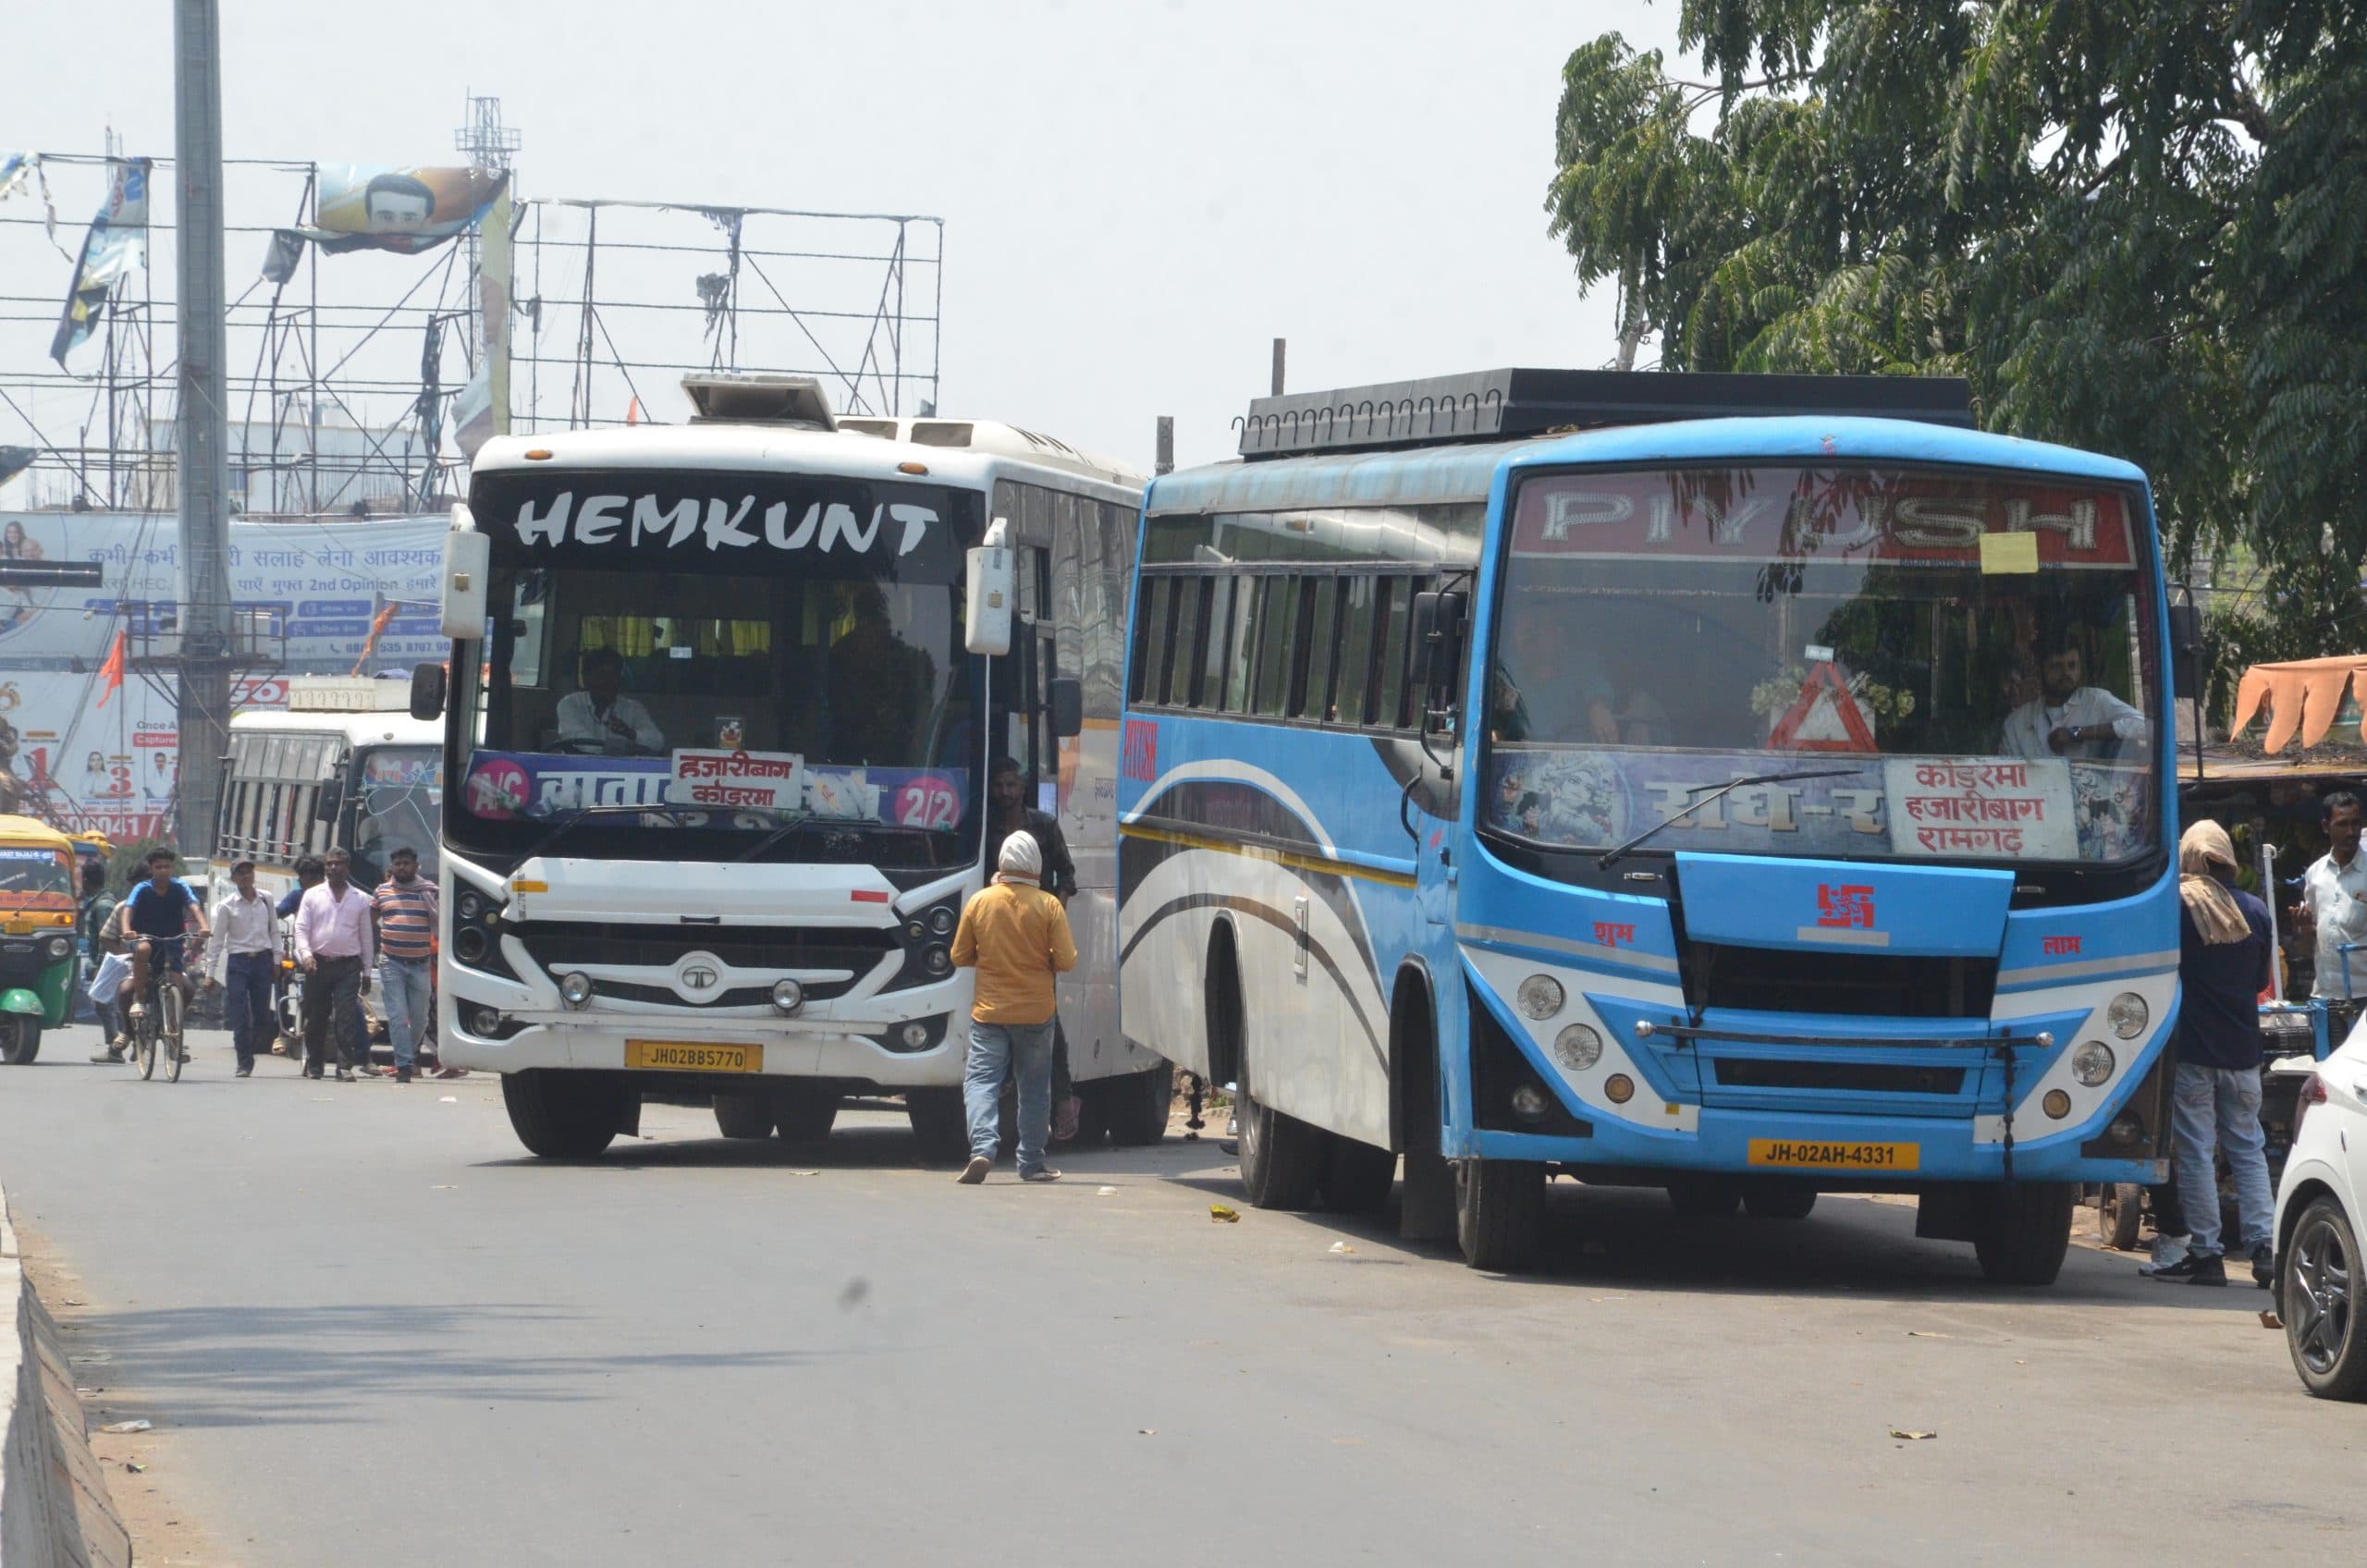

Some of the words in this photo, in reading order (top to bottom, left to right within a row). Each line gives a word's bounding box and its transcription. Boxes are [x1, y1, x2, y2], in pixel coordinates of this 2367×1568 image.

[514, 491, 939, 556] HEMKUNT
[1541, 492, 2096, 549] PIYUSH
[254, 550, 304, 568] सलाह
[317, 545, 354, 567] लेना
[364, 549, 442, 566] आवश्यक
[310, 578, 337, 591] 2nd
[340, 578, 399, 594] Opinion
[229, 681, 288, 703] GO
[137, 720, 166, 730] Once
[679, 750, 792, 779] हजारीबाग
[1916, 760, 2028, 790] कोडरमा
[468, 771, 522, 811] A/C
[692, 778, 776, 807] कोडरमा
[901, 788, 953, 828] 2/2
[1906, 790, 2045, 823] हजारीबाग
[1592, 921, 1636, 948] शुभ
[2042, 936, 2081, 955] लाभ
[650, 1047, 743, 1068] JH02BB5770
[1766, 1144, 1895, 1165] JH-02AH-4331
